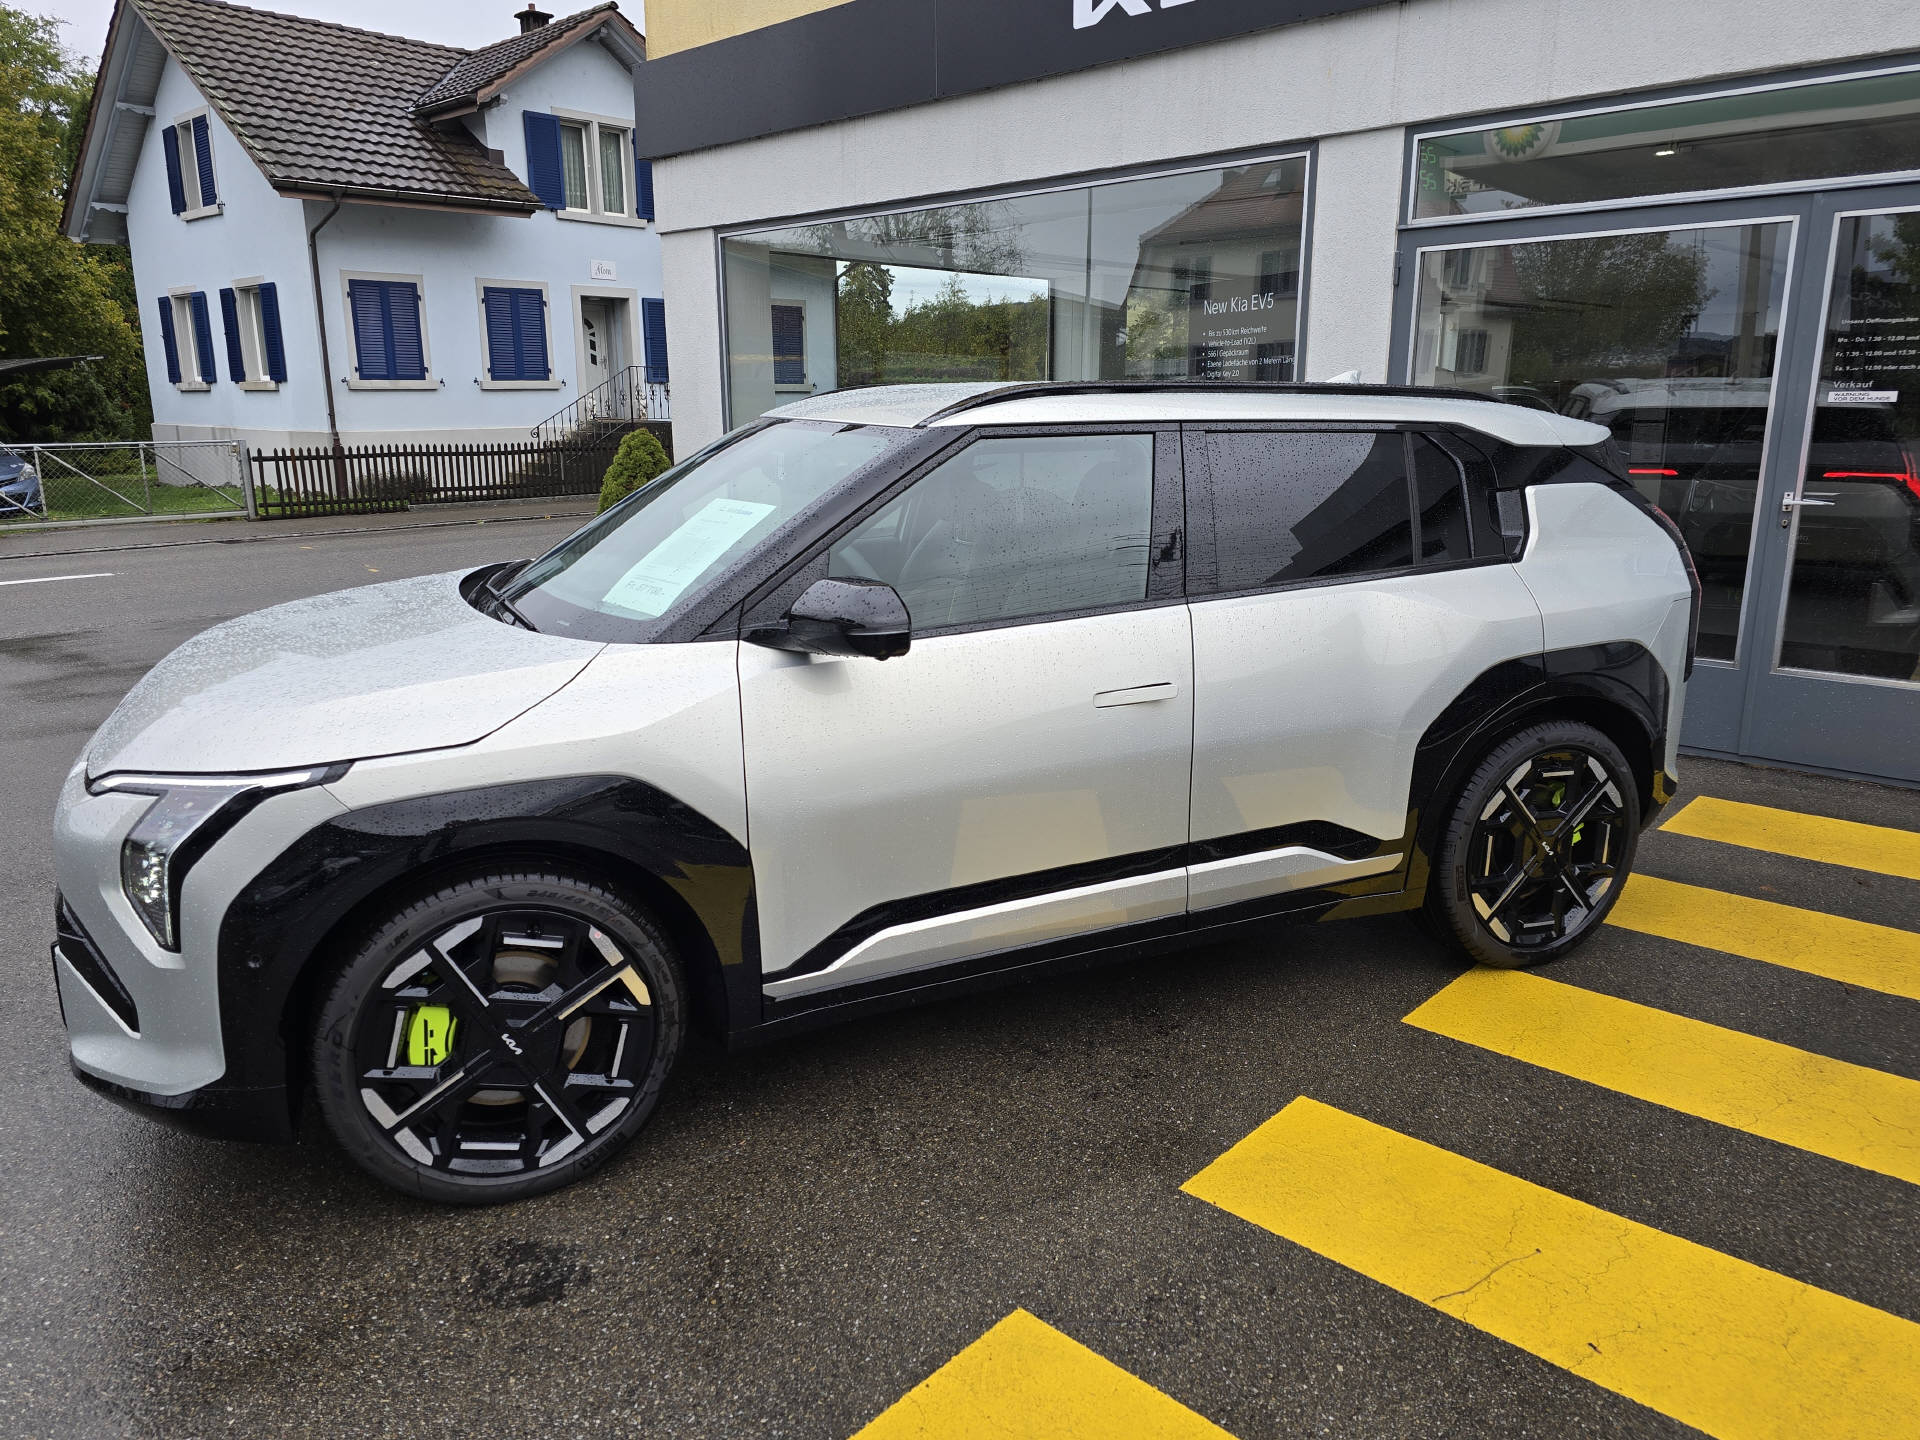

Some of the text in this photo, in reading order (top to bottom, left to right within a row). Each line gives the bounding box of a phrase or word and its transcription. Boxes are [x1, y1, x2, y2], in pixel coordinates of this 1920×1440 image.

[1203, 292, 1275, 316] New Kia EV5
[1208, 329, 1216, 337] Bis
[1240, 326, 1267, 335] Reichweite
[1208, 336, 1257, 348] Vehicle-to-Load (V2L)
[1207, 360, 1222, 368] Ebene
[1263, 356, 1282, 364] Metern
[1206, 369, 1240, 379] Digital Key 2.0
[1833, 380, 1874, 389] Verkauf
